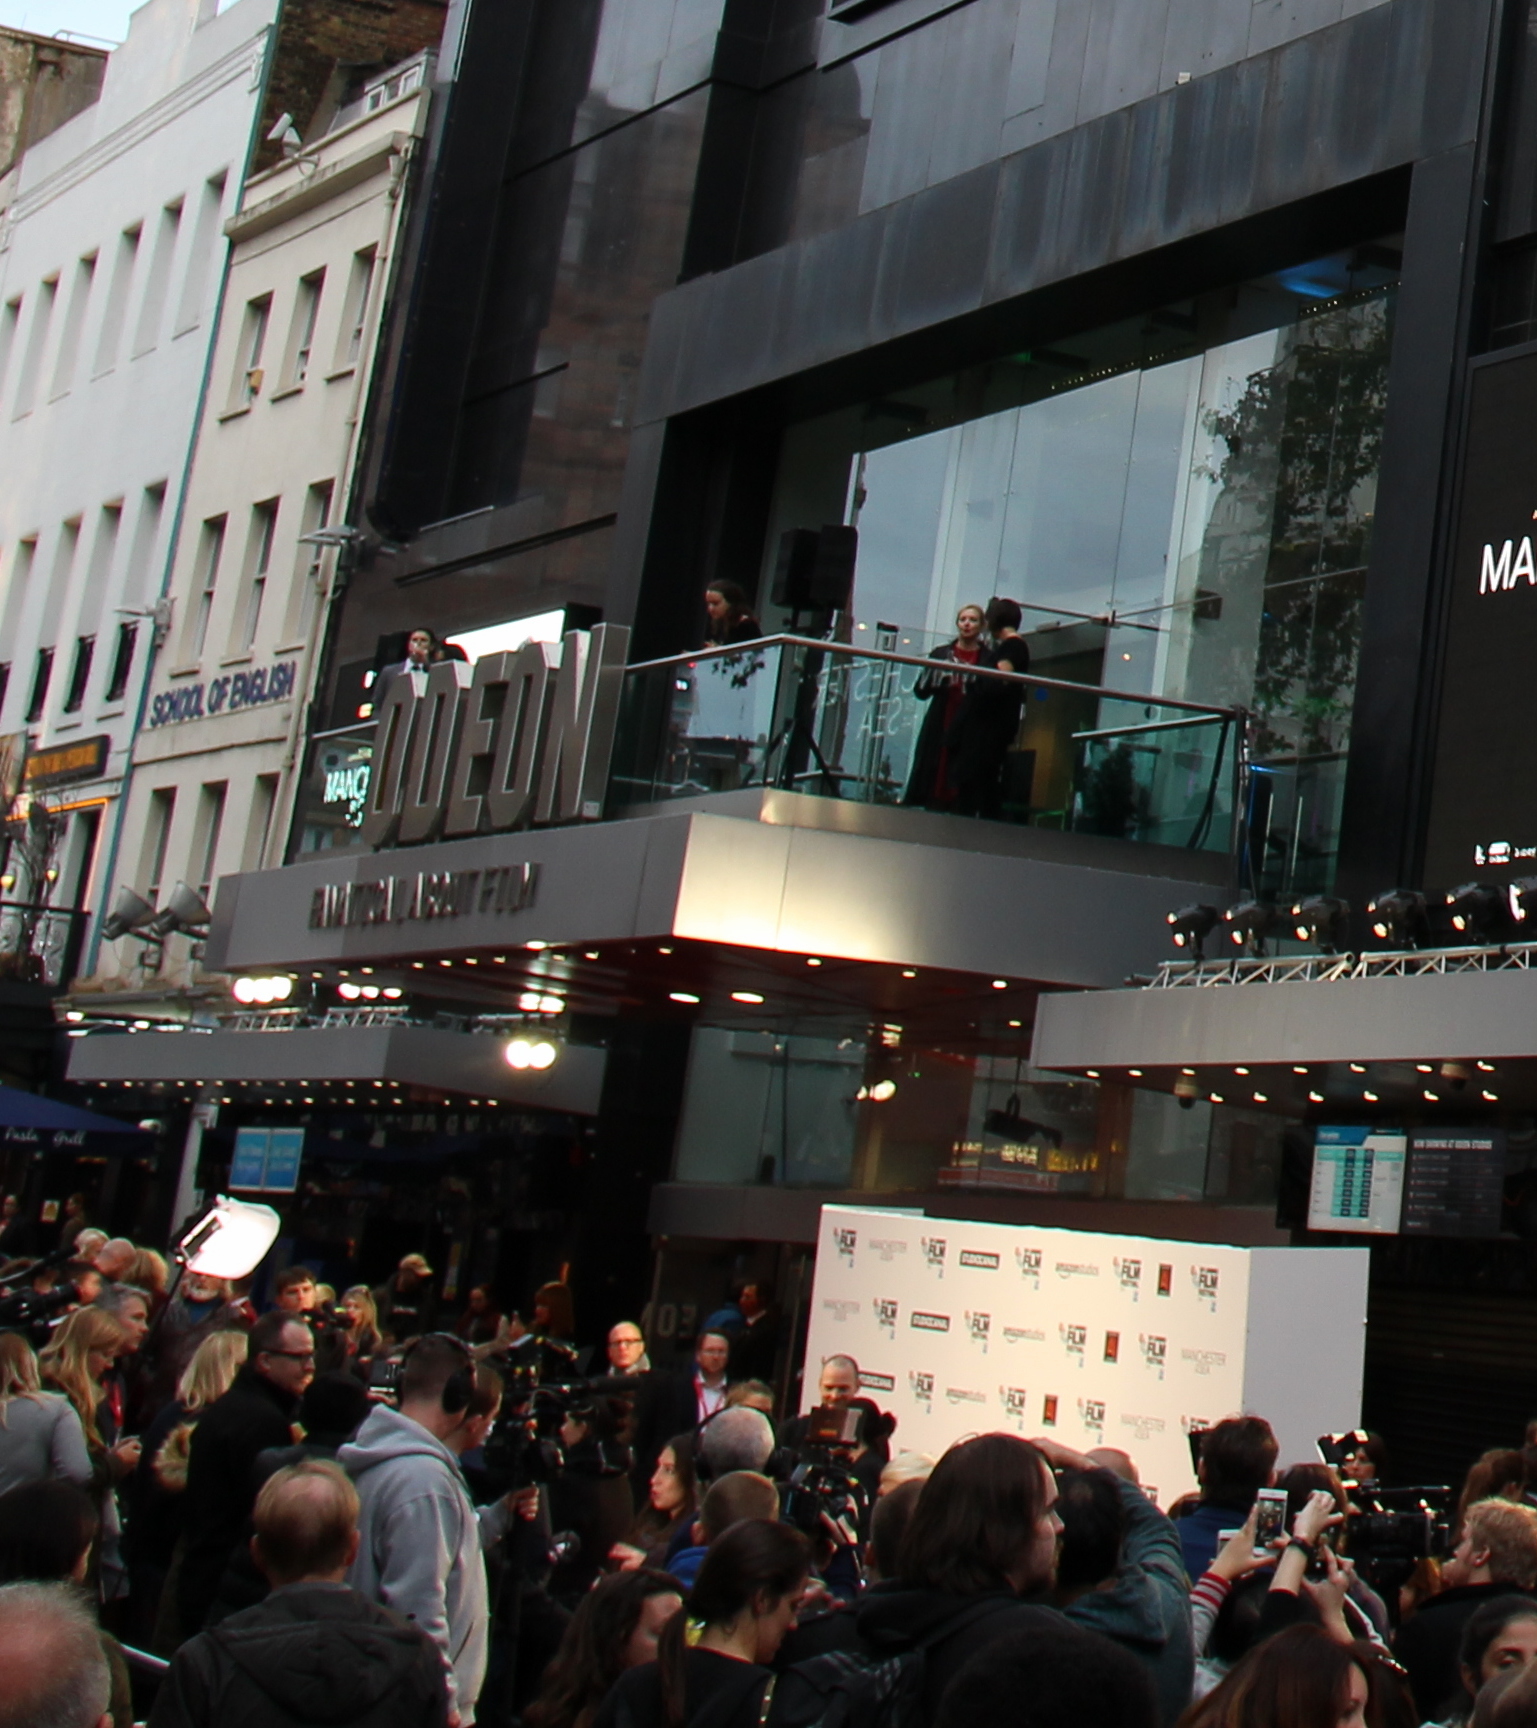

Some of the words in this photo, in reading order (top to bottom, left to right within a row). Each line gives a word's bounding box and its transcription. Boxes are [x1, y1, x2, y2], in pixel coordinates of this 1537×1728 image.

[150, 683, 205, 728] SCHOOL
[207, 675, 231, 713] OF
[228, 660, 297, 710] ENGLISH
[360, 622, 630, 849] ODEON
